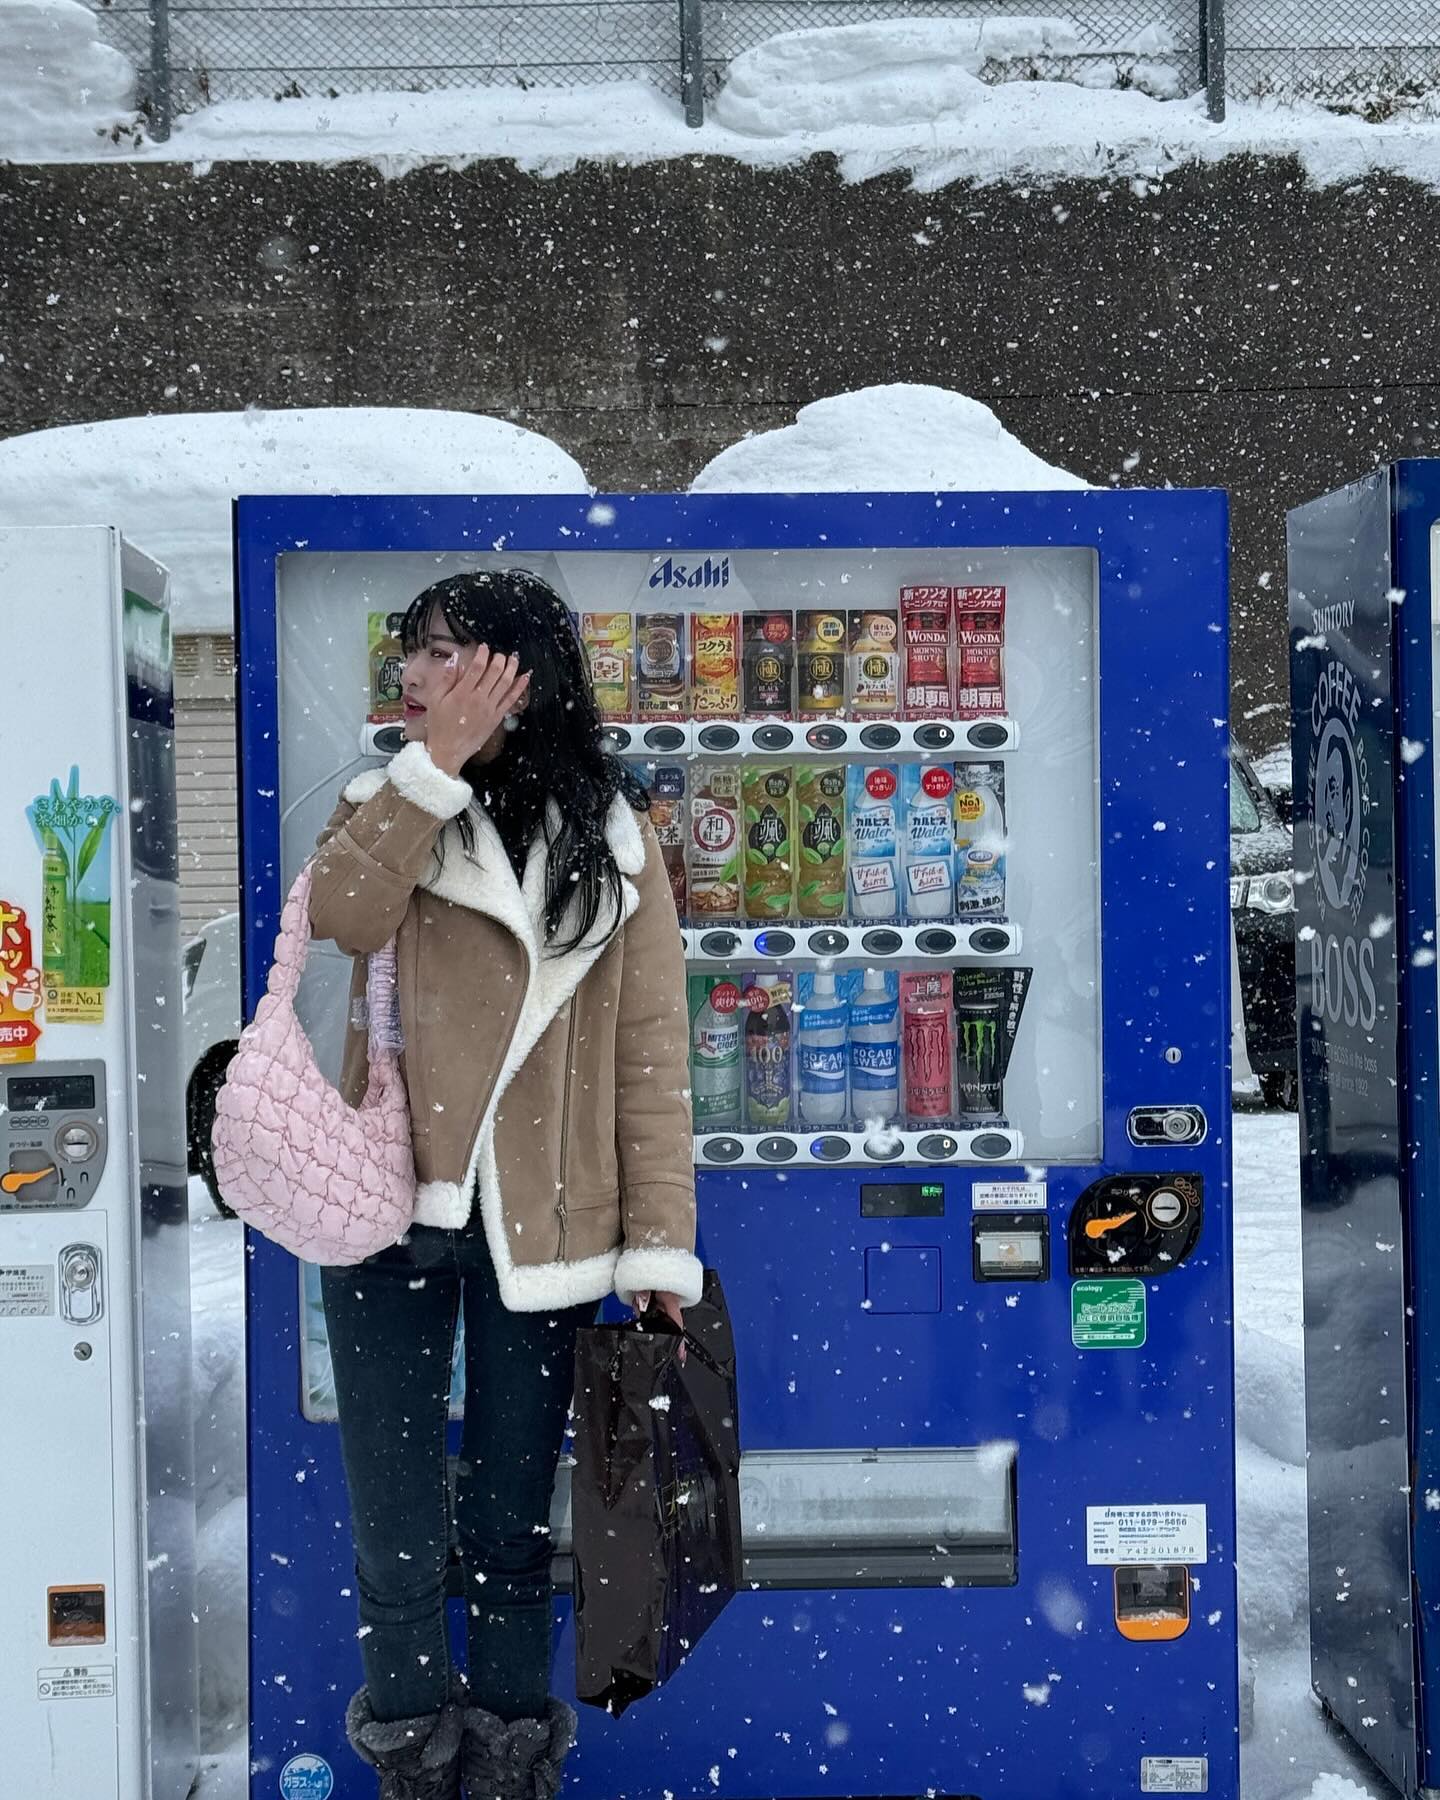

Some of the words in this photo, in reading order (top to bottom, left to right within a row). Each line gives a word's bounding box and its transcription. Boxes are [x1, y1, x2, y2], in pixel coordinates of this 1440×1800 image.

[649, 557, 729, 589] Asahi
[1312, 600, 1354, 635] SUNTORY
[907, 630, 946, 643] WONDA
[961, 631, 1000, 644] WONDA
[693, 693, 738, 711] たっぷり
[1312, 661, 1361, 736] COFFEE
[856, 817, 890, 827] カルピス
[913, 816, 947, 826] カルピス
[854, 827, 892, 840] Water
[911, 826, 948, 839] Water
[911, 980, 941, 995] 上陸
[1311, 933, 1376, 1031] BOSS
[75, 992, 102, 1006] No.1
[803, 1052, 844, 1062] POCAR
[854, 1047, 896, 1058] POCARI
[854, 1057, 893, 1067] SWEAT
[1364, 1053, 1378, 1073] boss
[1076, 1285, 1103, 1293] ecology
